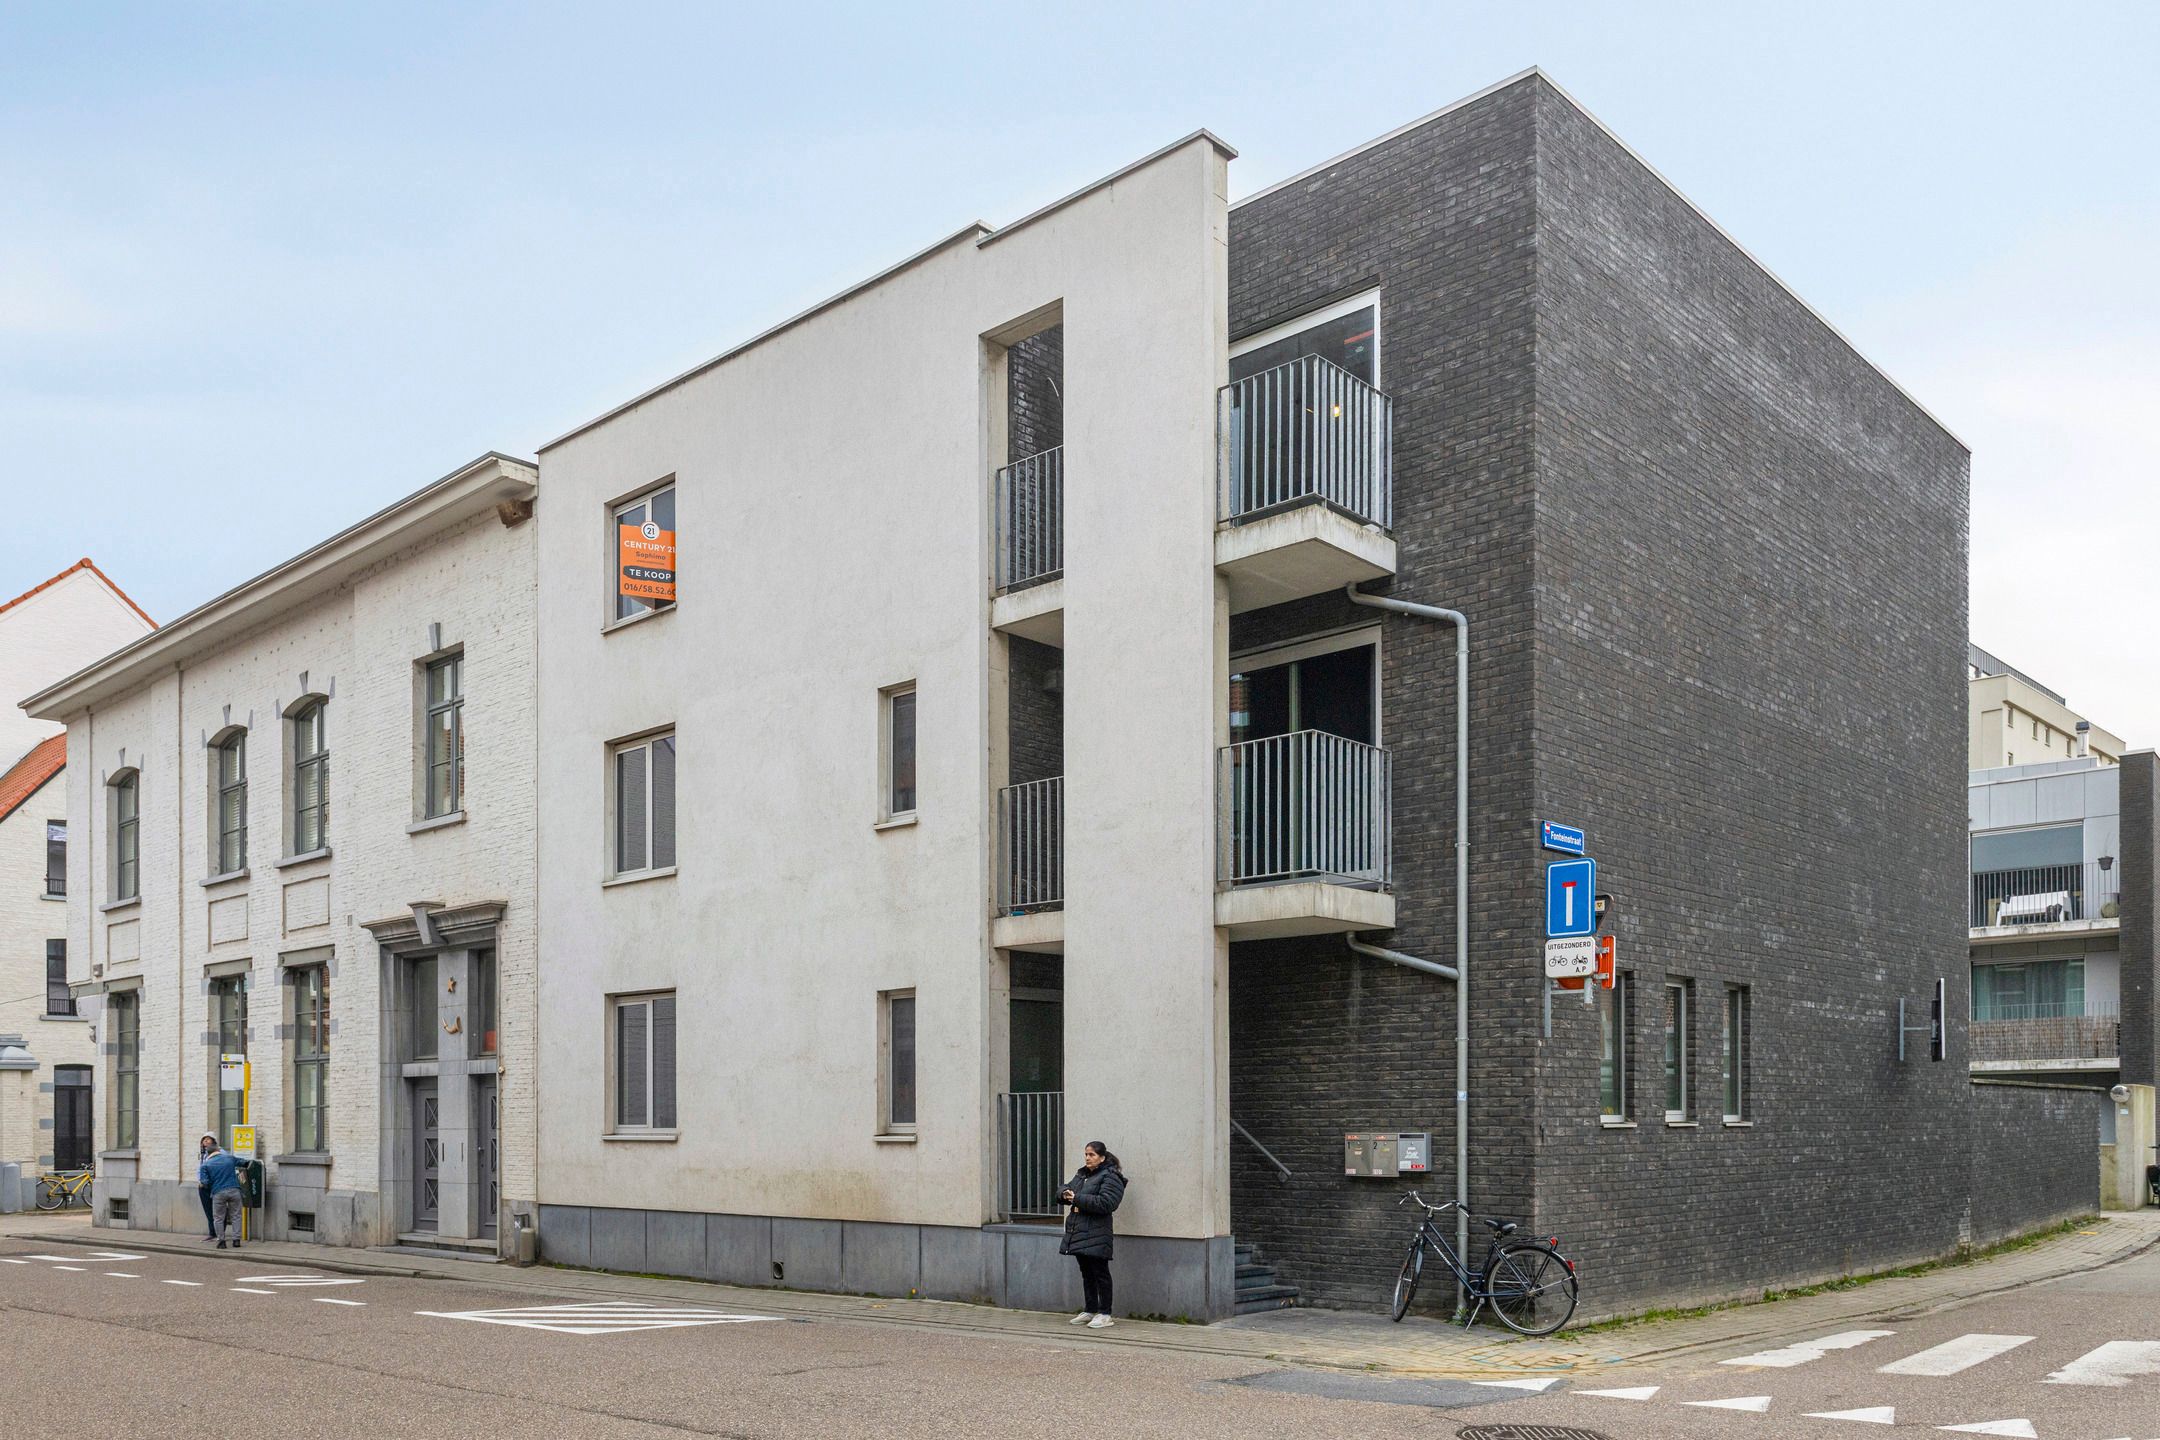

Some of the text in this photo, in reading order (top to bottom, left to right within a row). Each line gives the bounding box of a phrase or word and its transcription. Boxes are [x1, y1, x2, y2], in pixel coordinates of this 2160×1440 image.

[624, 540, 666, 552] CENTURY
[635, 551, 666, 560] Sophimo
[644, 571, 671, 579] KOOP
[1547, 941, 1592, 951] UITGEZONDERD
